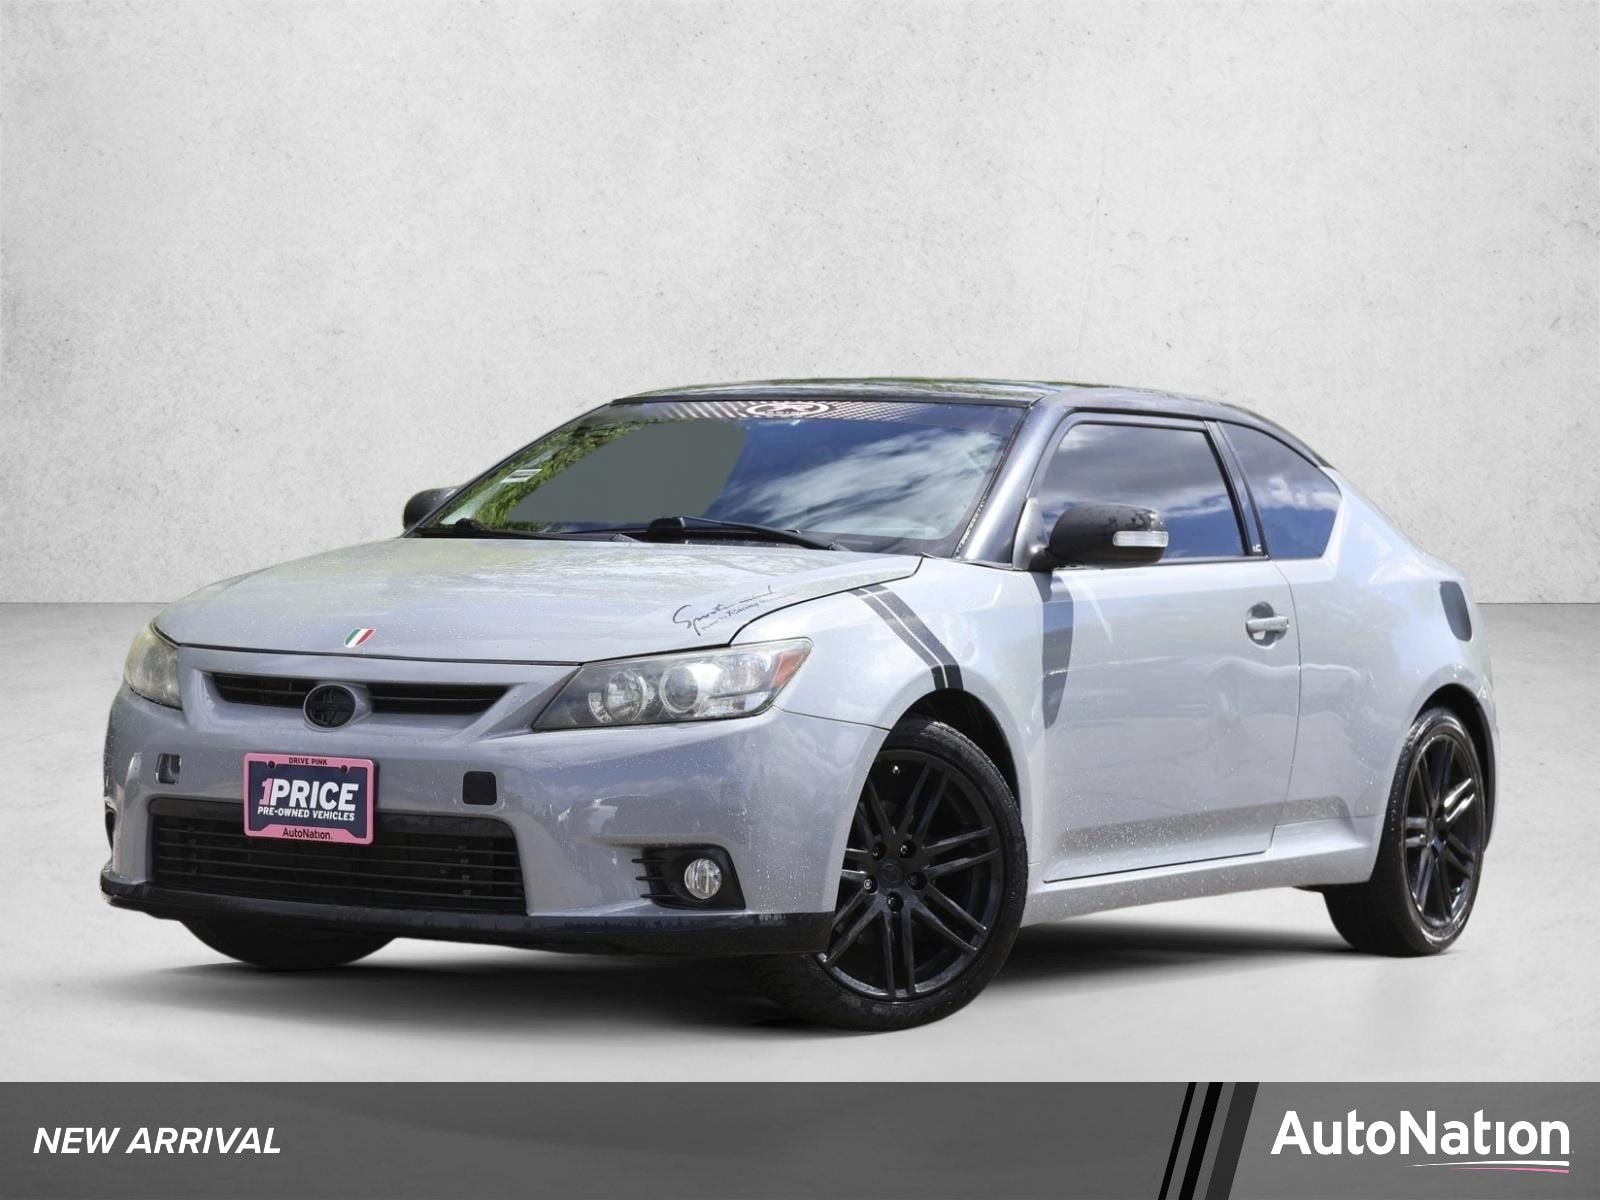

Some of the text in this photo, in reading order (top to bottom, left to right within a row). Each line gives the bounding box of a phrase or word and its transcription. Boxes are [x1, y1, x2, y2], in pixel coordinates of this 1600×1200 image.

[288, 757, 328, 766] DRIVE PINK
[257, 806, 355, 822] PRE-OWNED VEHICLES
